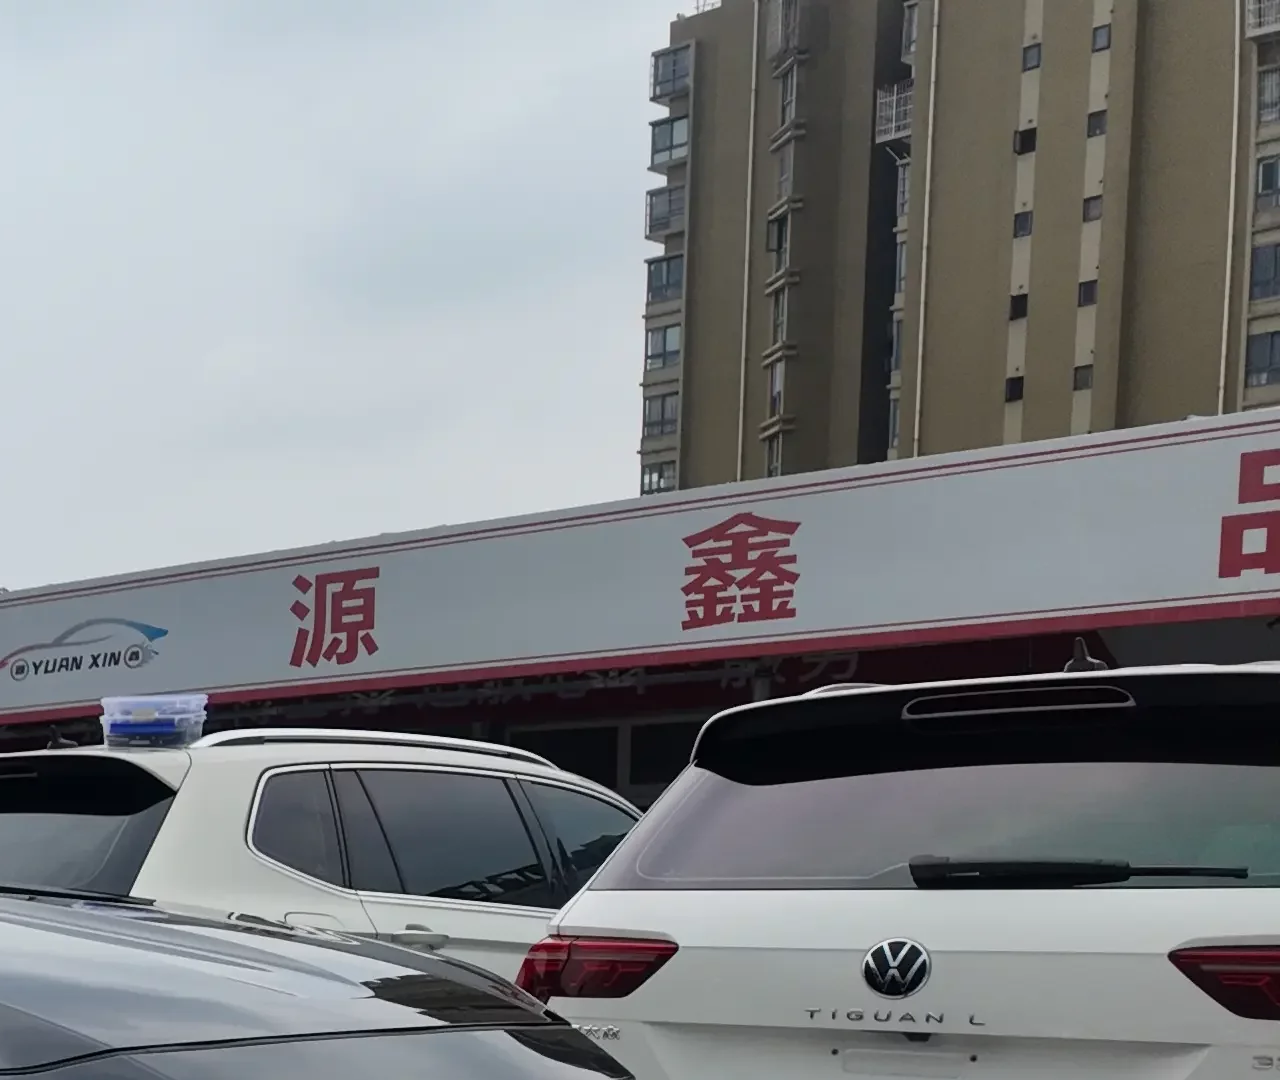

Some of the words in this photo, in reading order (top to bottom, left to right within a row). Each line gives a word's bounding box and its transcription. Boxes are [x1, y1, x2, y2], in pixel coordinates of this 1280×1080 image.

[32, 656, 83, 676] YUAN
[88, 651, 122, 670] XIN
[804, 1007, 945, 1024] TIGUAN
[968, 1014, 986, 1026] L
